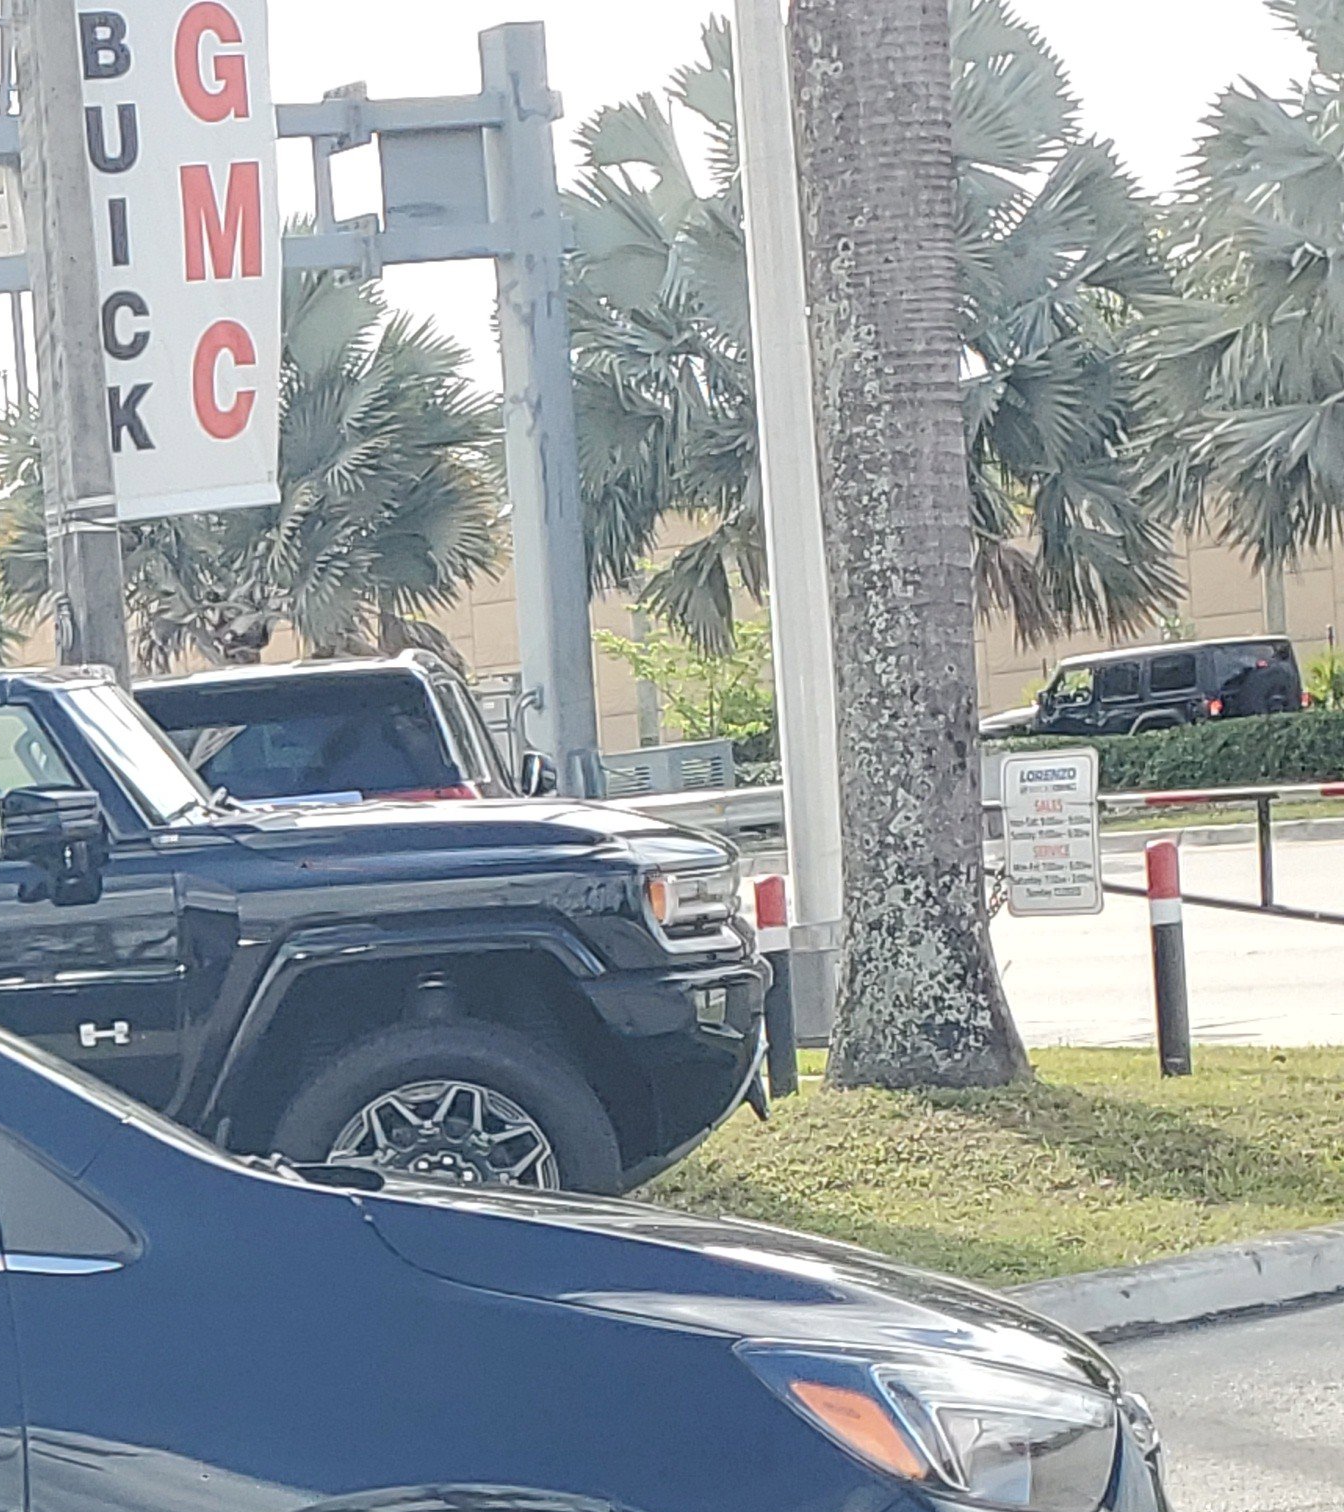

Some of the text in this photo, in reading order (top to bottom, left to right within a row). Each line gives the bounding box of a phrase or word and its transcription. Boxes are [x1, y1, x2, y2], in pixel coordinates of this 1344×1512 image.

[78, 11, 155, 454] BUICK
[174, 0, 263, 441] GMC
[1020, 767, 1077, 783] LORENZO
